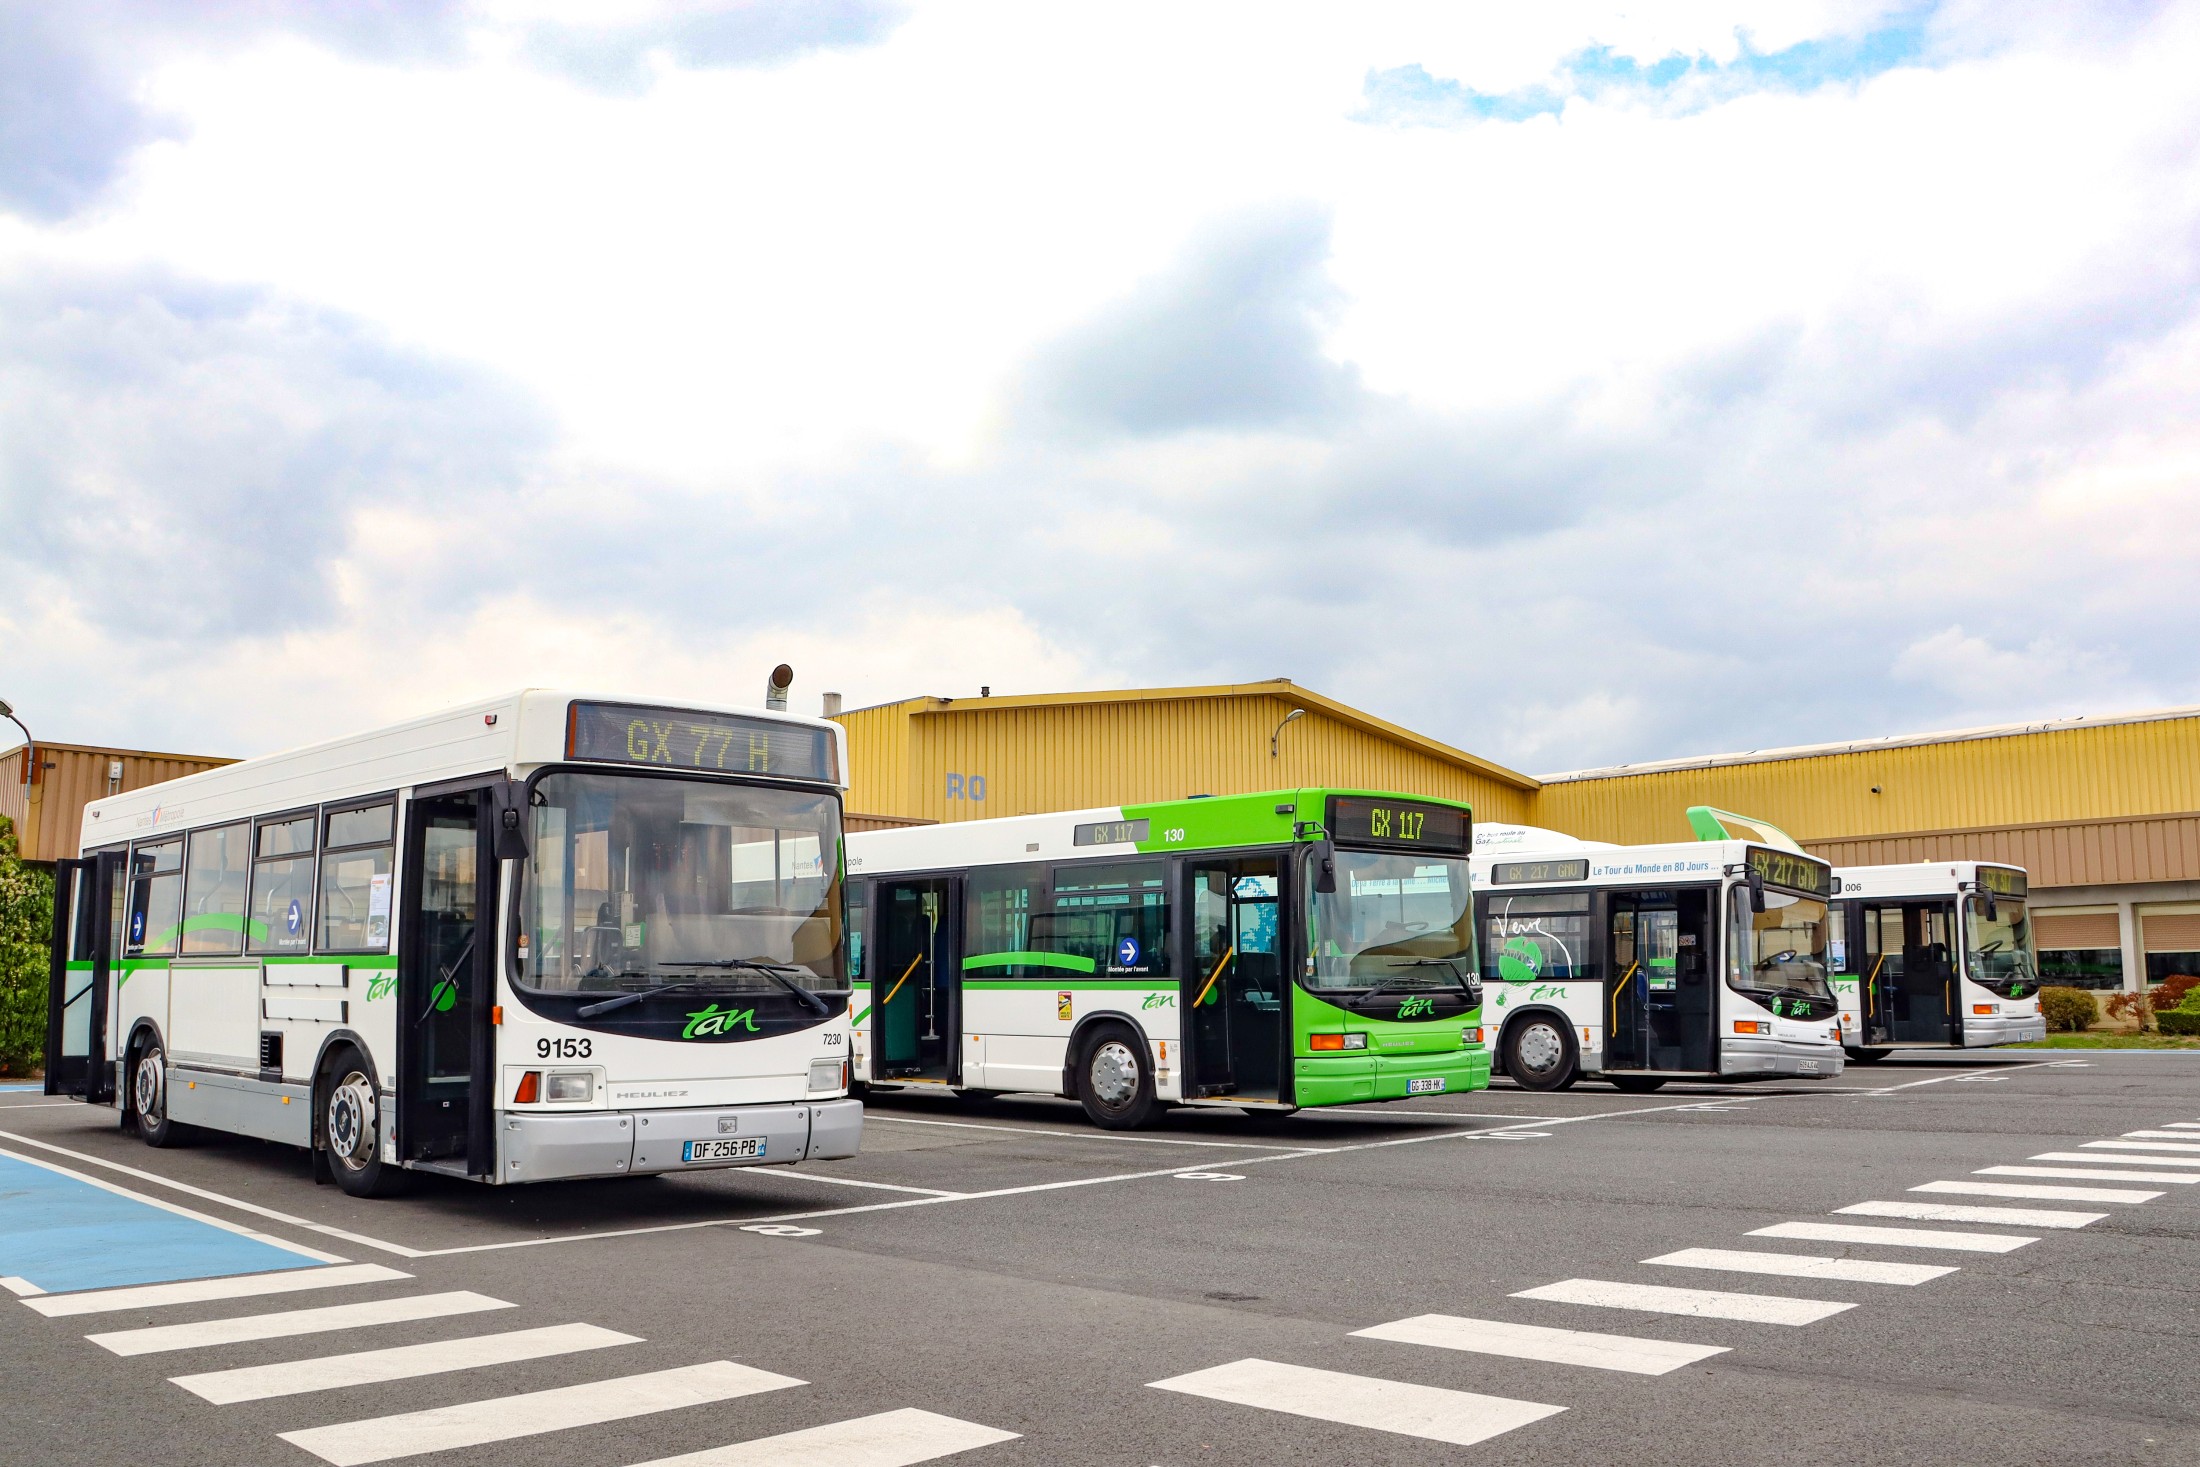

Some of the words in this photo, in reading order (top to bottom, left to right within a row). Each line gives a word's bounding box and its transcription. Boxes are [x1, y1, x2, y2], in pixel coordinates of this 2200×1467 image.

[627, 720, 672, 762] GX
[690, 726, 733, 768] 77
[749, 732, 768, 772] H
[1371, 808, 1391, 838] GX
[1399, 811, 1424, 839] 117
[1094, 825, 1108, 843] GX
[1114, 823, 1134, 842] 117
[1164, 828, 1184, 842] 130
[1509, 866, 1522, 880] GX
[1531, 864, 1549, 879] 217
[1557, 863, 1578, 878] GNV
[1593, 866, 1602, 876] Le
[1604, 865, 1621, 875] Tour
[1624, 864, 1633, 874] du
[1635, 863, 1660, 874] Monde
[1663, 864, 1672, 873] en
[1674, 861, 1685, 872] 80
[1687, 861, 1709, 872] Jours
[1774, 857, 1794, 885] 217
[1798, 863, 1818, 892] GNV
[1845, 883, 1862, 891] 006
[1466, 972, 1480, 985] 130
[1141, 992, 1177, 1010] tan
[1529, 984, 1568, 1001] tan
[1398, 995, 1435, 1019] tan
[1790, 999, 1812, 1017] tan
[682, 1004, 760, 1039] tan
[536, 1038, 592, 1059] 9153
[823, 1033, 842, 1046] 7230
[616, 1090, 689, 1099] HEULIEZ
